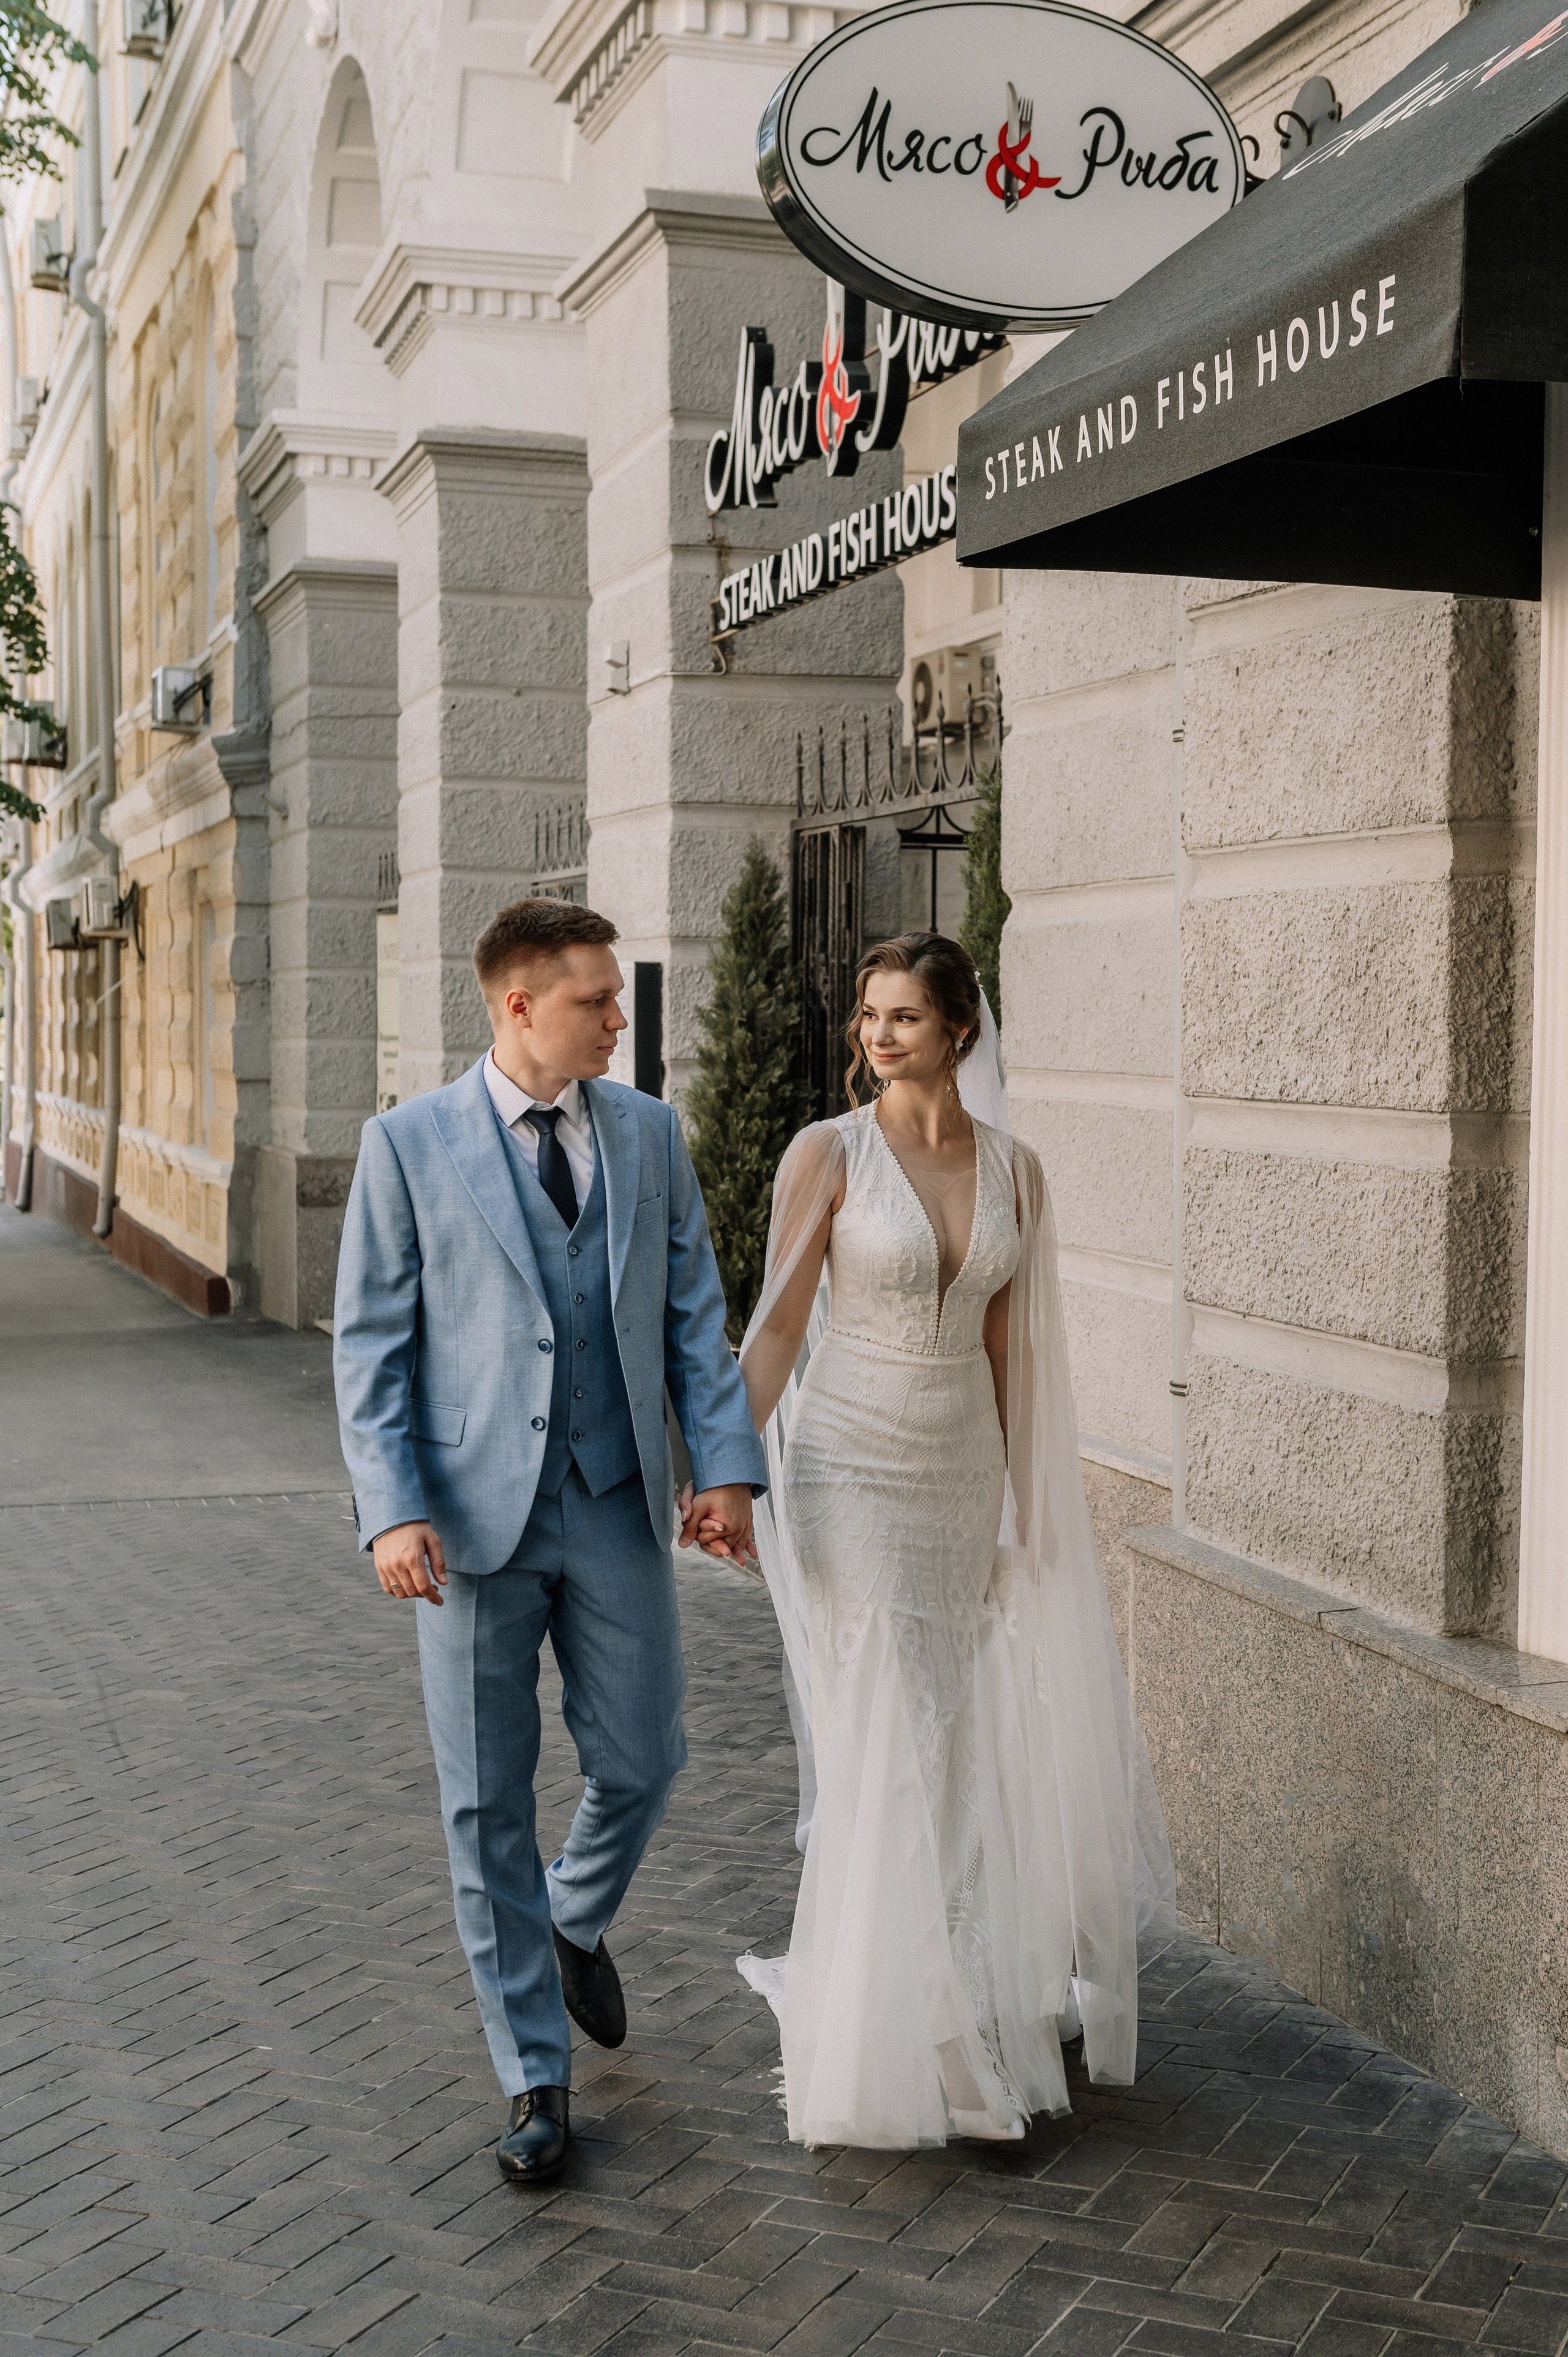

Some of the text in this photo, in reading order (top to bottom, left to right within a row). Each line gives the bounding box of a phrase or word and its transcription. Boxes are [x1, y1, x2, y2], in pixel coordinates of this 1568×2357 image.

[800, 86, 1219, 201] Мясо & Рыба
[704, 325, 811, 511] Мясо
[984, 274, 1396, 500] STEAK AND FISH HOUSE
[719, 464, 956, 631] STEAK AND FISH HOUS
